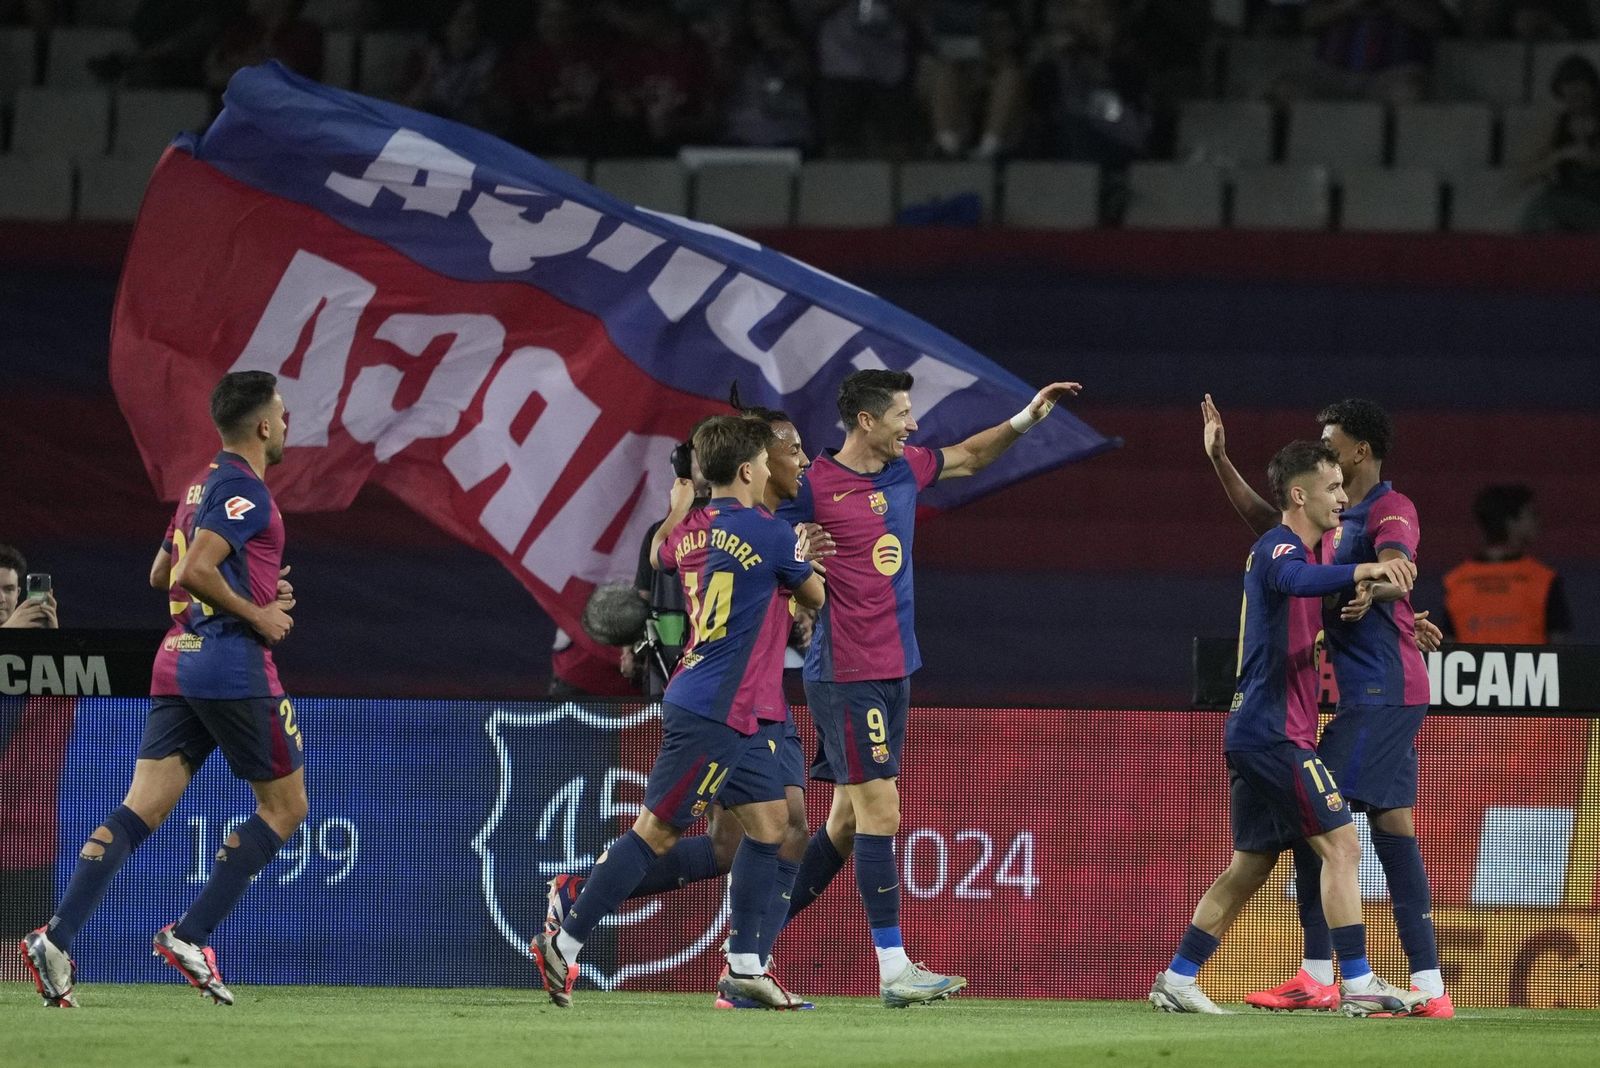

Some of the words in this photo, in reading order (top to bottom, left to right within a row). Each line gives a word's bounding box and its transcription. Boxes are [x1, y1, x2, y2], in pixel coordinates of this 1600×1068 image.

[711, 528, 763, 572] TORRE
[684, 570, 735, 648] 14
[866, 707, 886, 744] 9
[187, 814, 360, 886] 199
[892, 828, 1039, 899] 024
